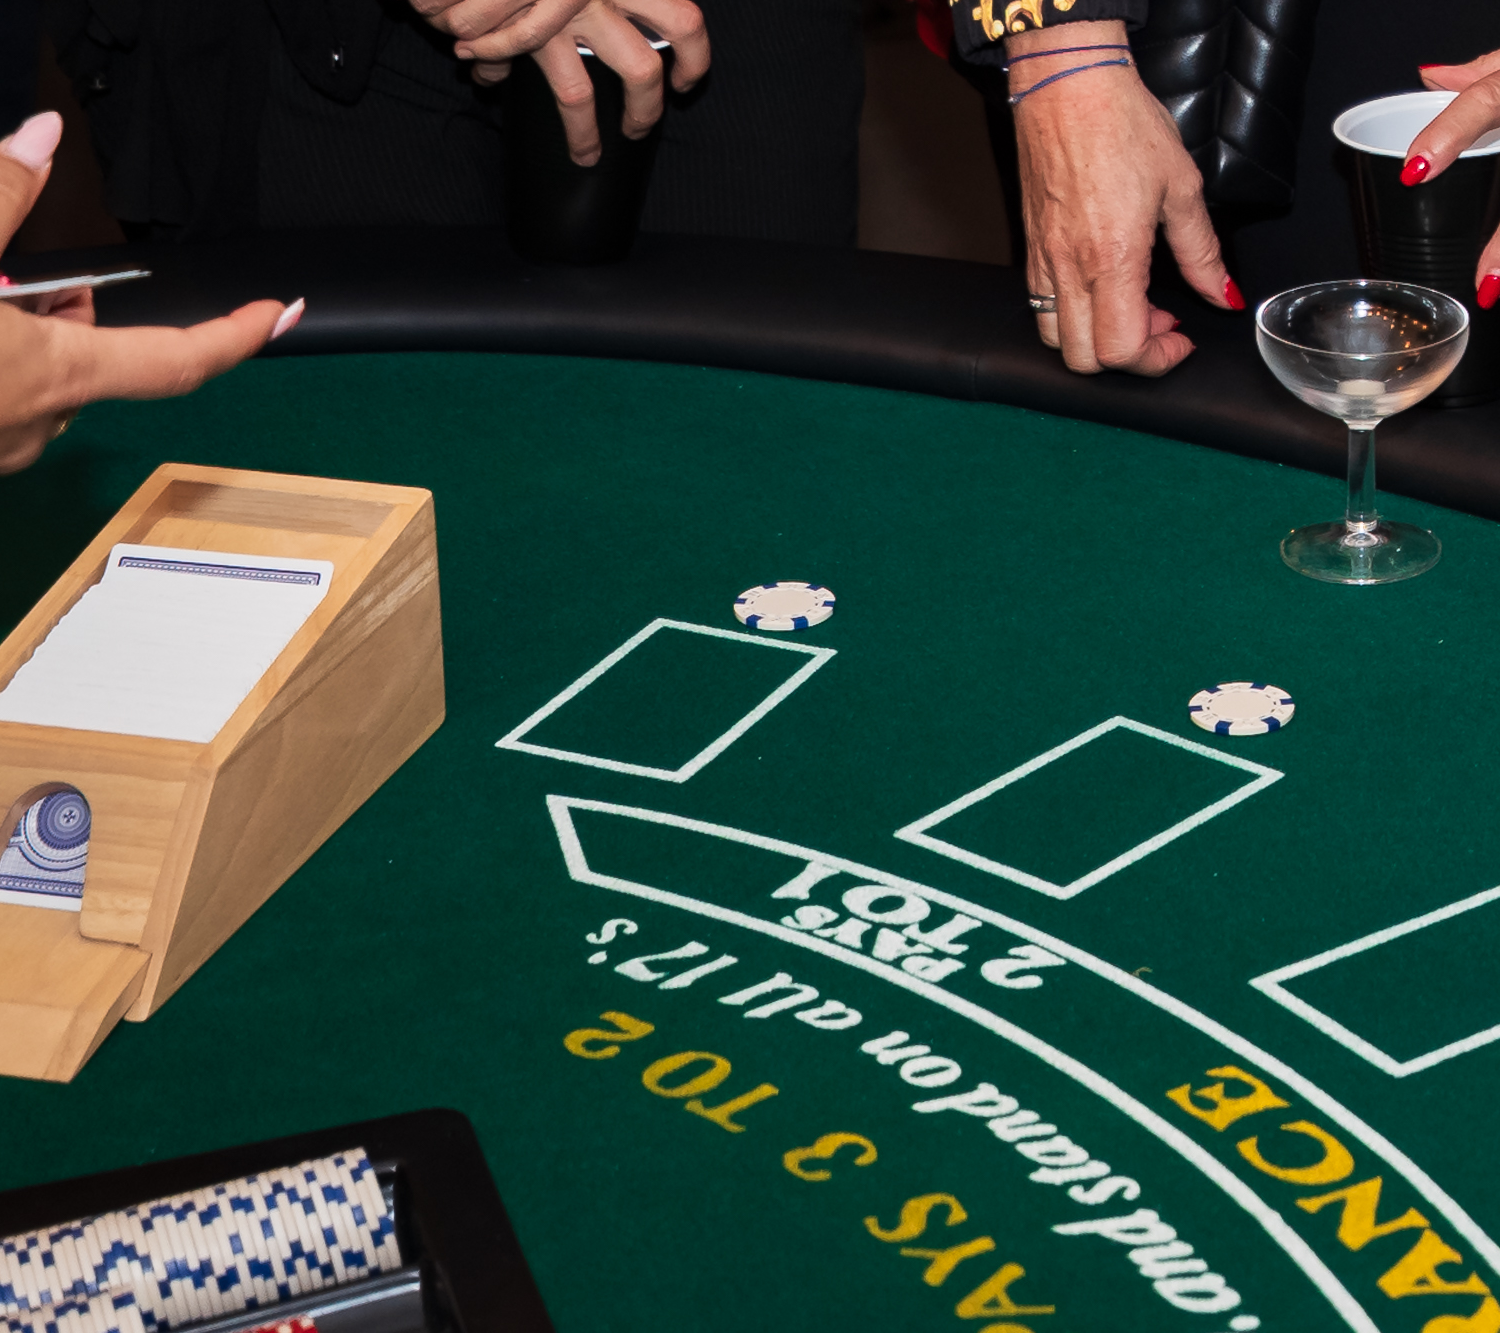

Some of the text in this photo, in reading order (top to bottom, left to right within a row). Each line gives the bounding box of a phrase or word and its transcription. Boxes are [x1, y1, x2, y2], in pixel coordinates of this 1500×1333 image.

[585, 918, 738, 989] 17's
[771, 860, 1067, 990] 2 TO 1
[780, 905, 967, 983] PAYS
[718, 972, 863, 1030] all
[860, 1030, 962, 1088] on
[562, 1011, 1056, 1333] AYS 3 TO 2
[912, 1082, 1141, 1205] stand
